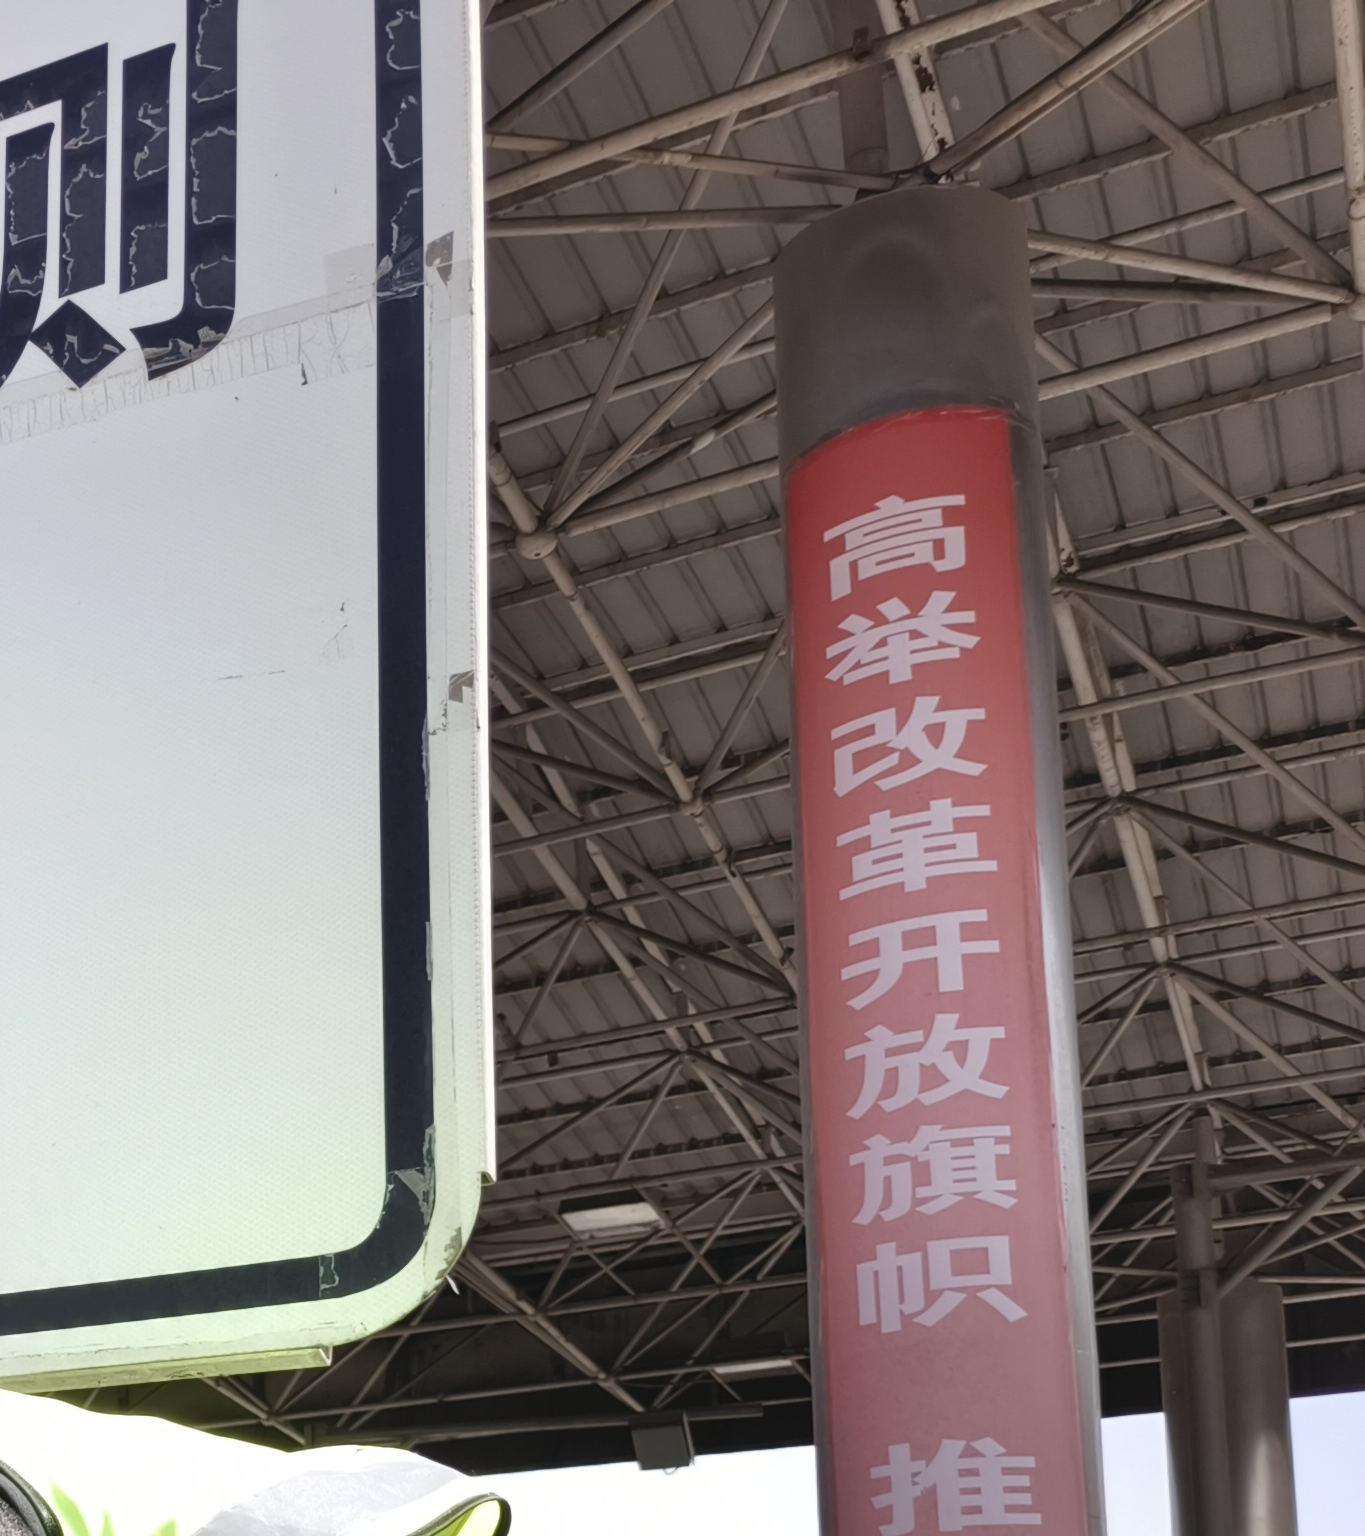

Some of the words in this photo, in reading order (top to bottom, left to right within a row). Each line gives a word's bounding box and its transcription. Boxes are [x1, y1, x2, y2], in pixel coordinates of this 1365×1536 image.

[823, 493, 1029, 1334] 高举改革开放旗帜
